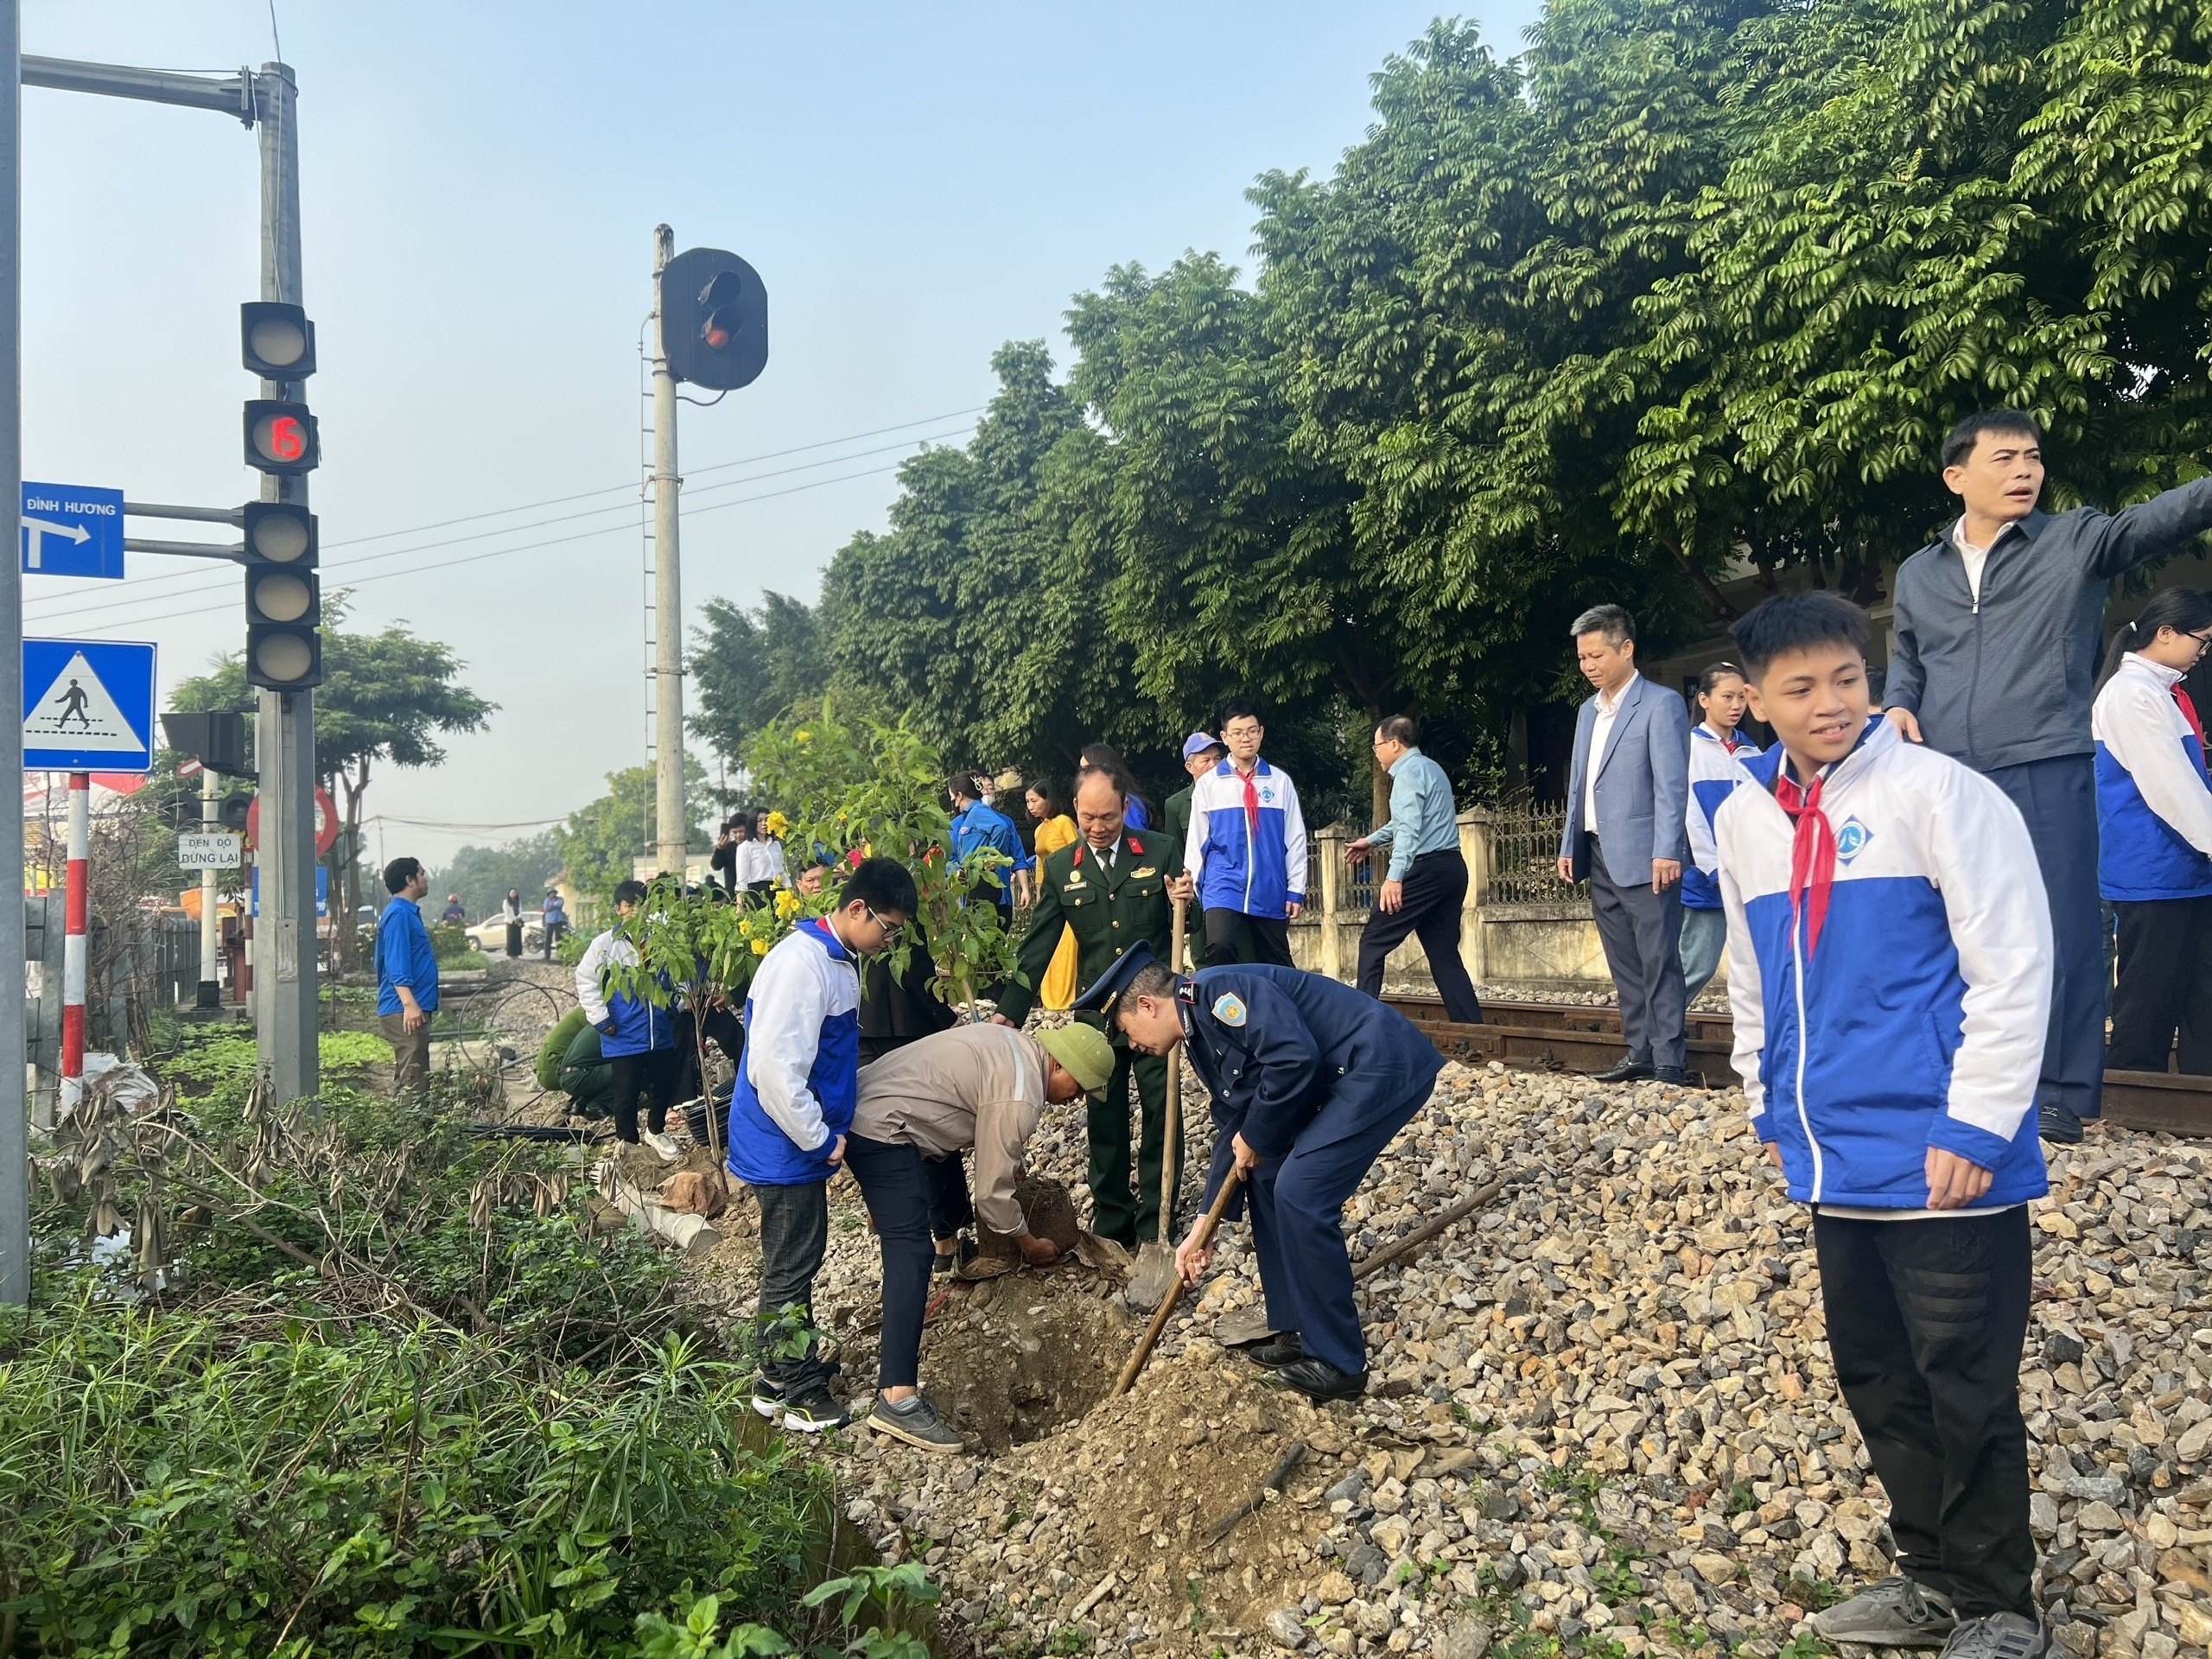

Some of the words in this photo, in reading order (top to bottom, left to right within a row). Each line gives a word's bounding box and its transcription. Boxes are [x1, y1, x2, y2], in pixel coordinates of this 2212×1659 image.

[271, 416, 301, 459] 15
[27, 496, 60, 512] ĐÌNH
[65, 501, 117, 516] HƯƠNG
